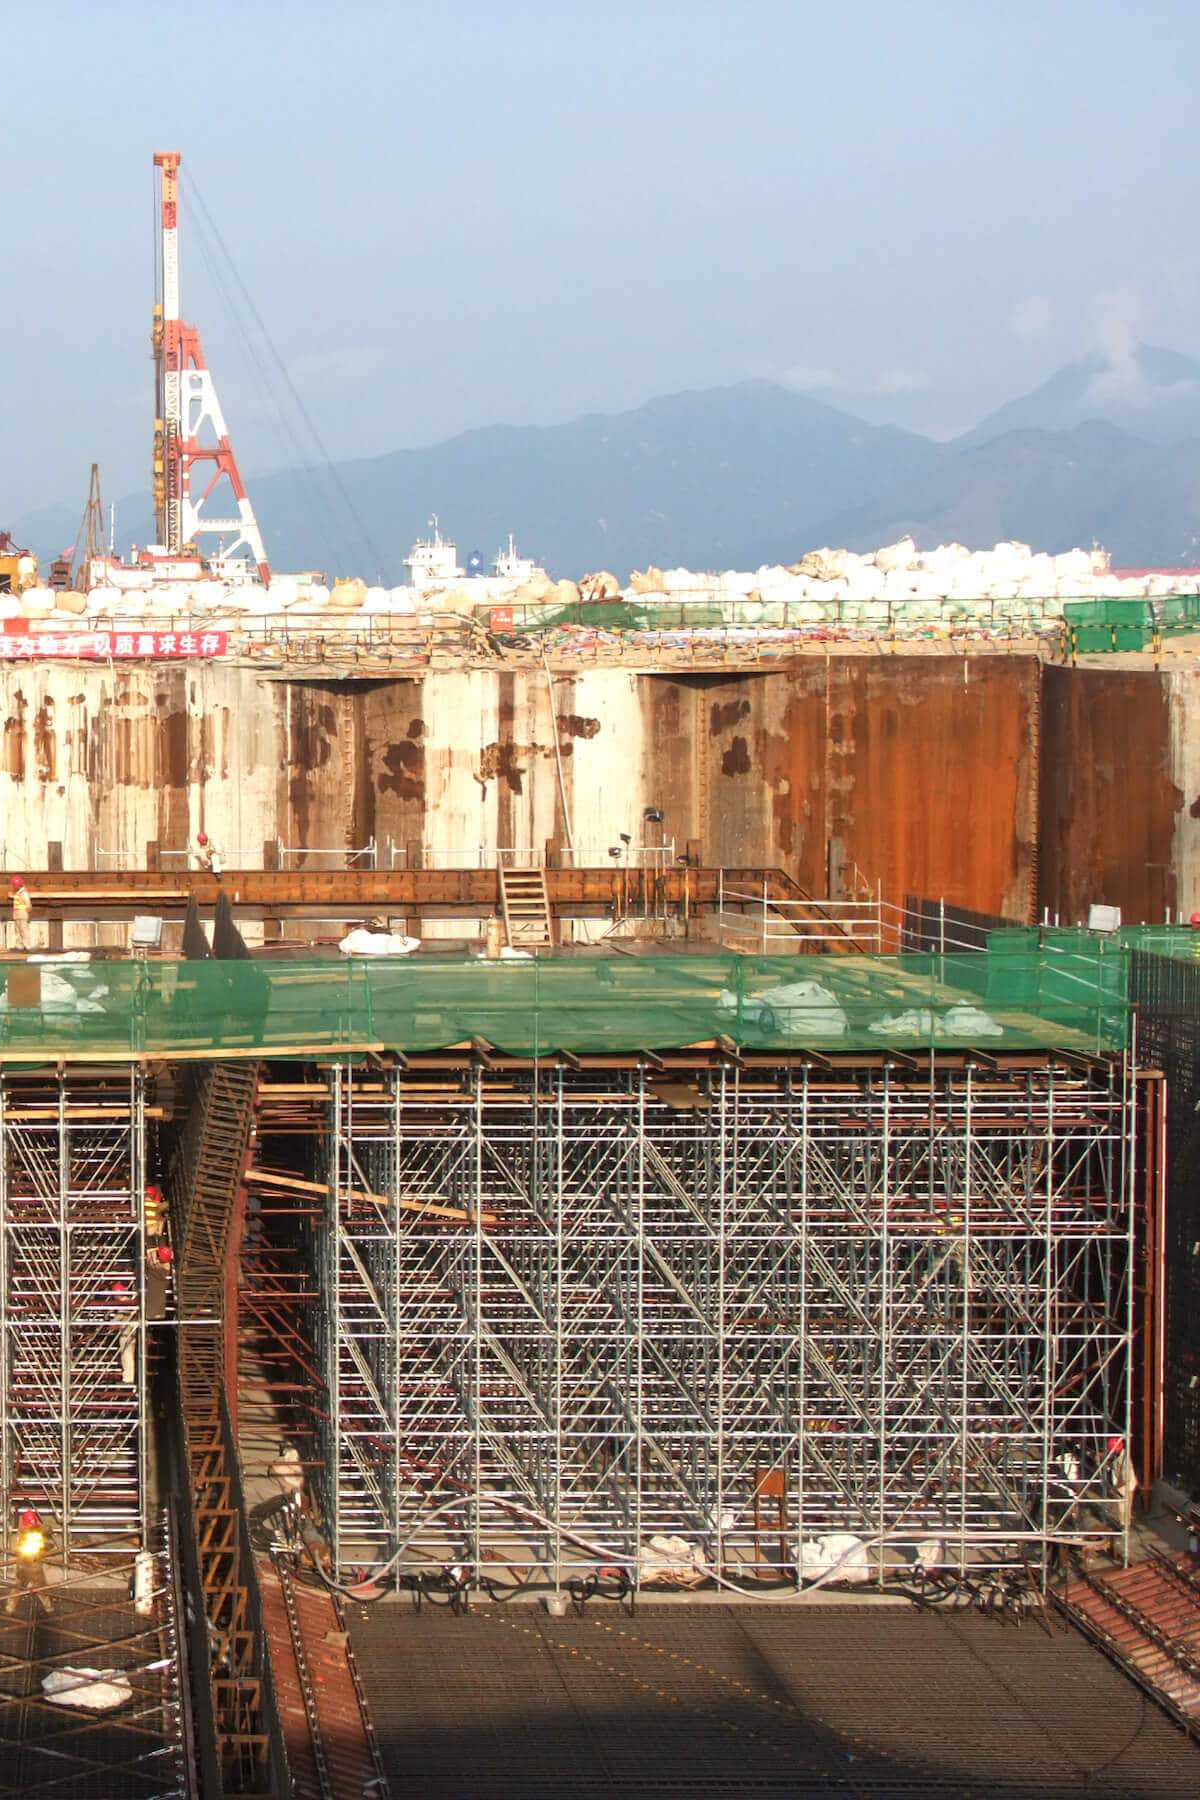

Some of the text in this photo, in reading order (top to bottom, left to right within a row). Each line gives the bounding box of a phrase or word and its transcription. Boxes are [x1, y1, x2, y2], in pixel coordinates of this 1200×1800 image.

[94, 633, 219, 656] 以质量求生存
